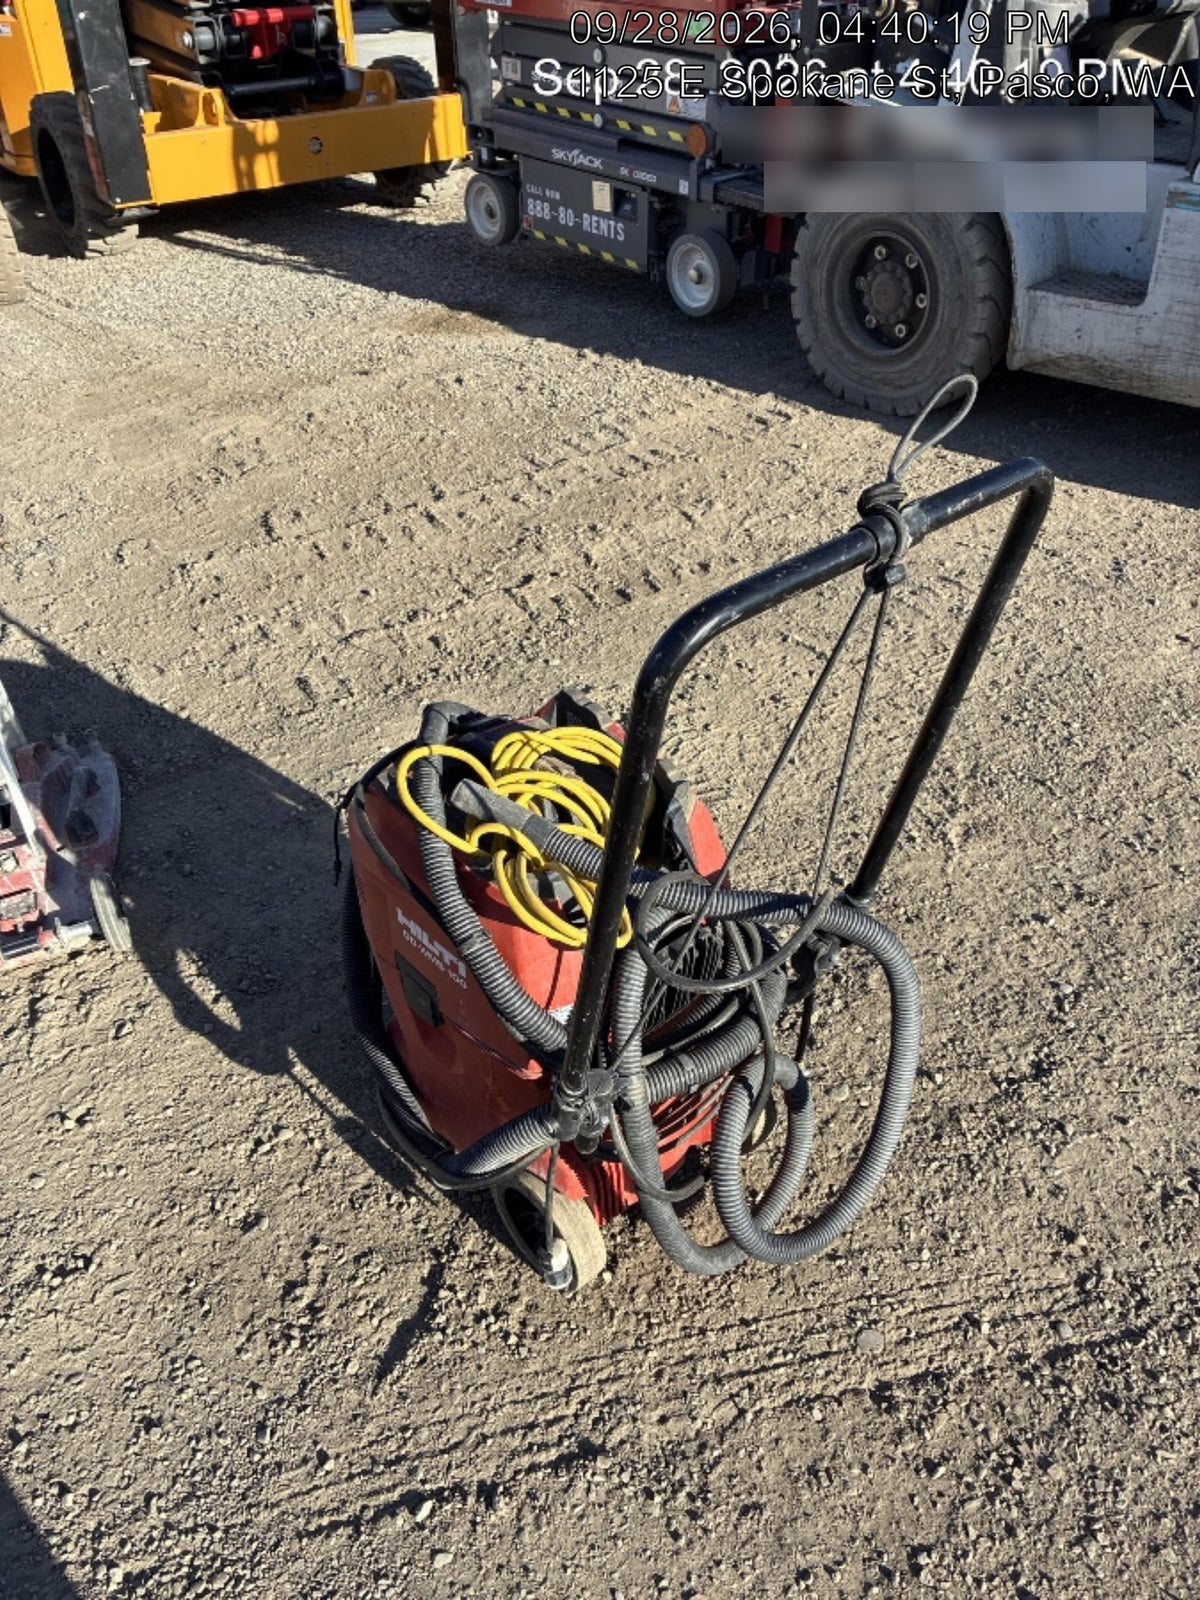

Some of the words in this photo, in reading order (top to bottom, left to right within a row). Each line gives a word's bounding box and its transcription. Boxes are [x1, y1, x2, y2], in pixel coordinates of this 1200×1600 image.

[526, 183, 543, 197] CALL
[545, 187, 561, 201] NOW
[527, 198, 626, 242] 888-80-RENTS
[396, 907, 467, 978] HILTI
